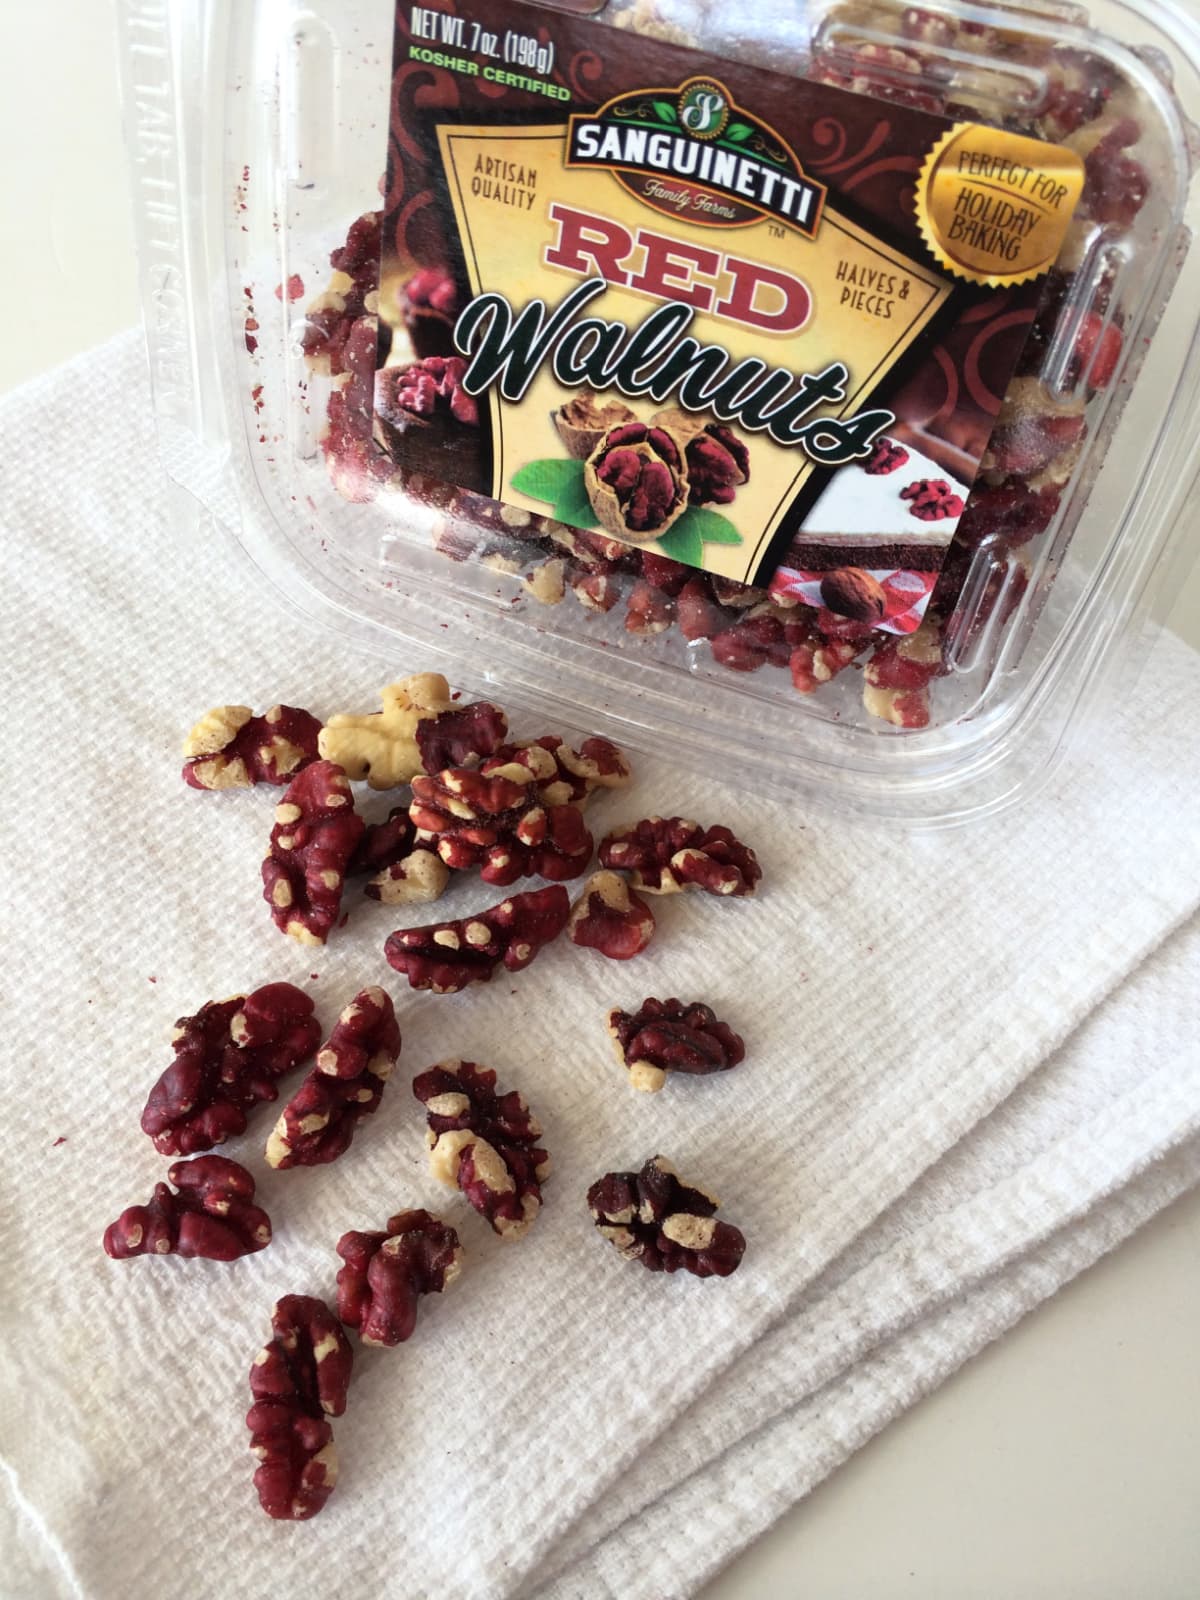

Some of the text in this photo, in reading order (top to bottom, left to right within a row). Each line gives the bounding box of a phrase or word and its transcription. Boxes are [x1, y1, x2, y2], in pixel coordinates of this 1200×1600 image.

[411, 7, 440, 40] NET
[441, 15, 467, 49] WT.
[504, 30, 554, 74] (198g)
[409, 47, 571, 101] KOSHER CERTIFIED
[472, 177, 536, 210] QUALITY
[475, 154, 537, 188] ARTISAN
[576, 124, 813, 223] SANGUINETTI
[958, 152, 1068, 208] PERFECT FOR
[642, 178, 737, 219] Family Farms
[954, 187, 1041, 236] HOLIDAY
[948, 214, 1022, 261] BAKING
[544, 202, 812, 334] RED
[836, 261, 911, 300] HALVES &
[840, 286, 895, 320] PIECES
[454, 278, 896, 465] Walnuts
